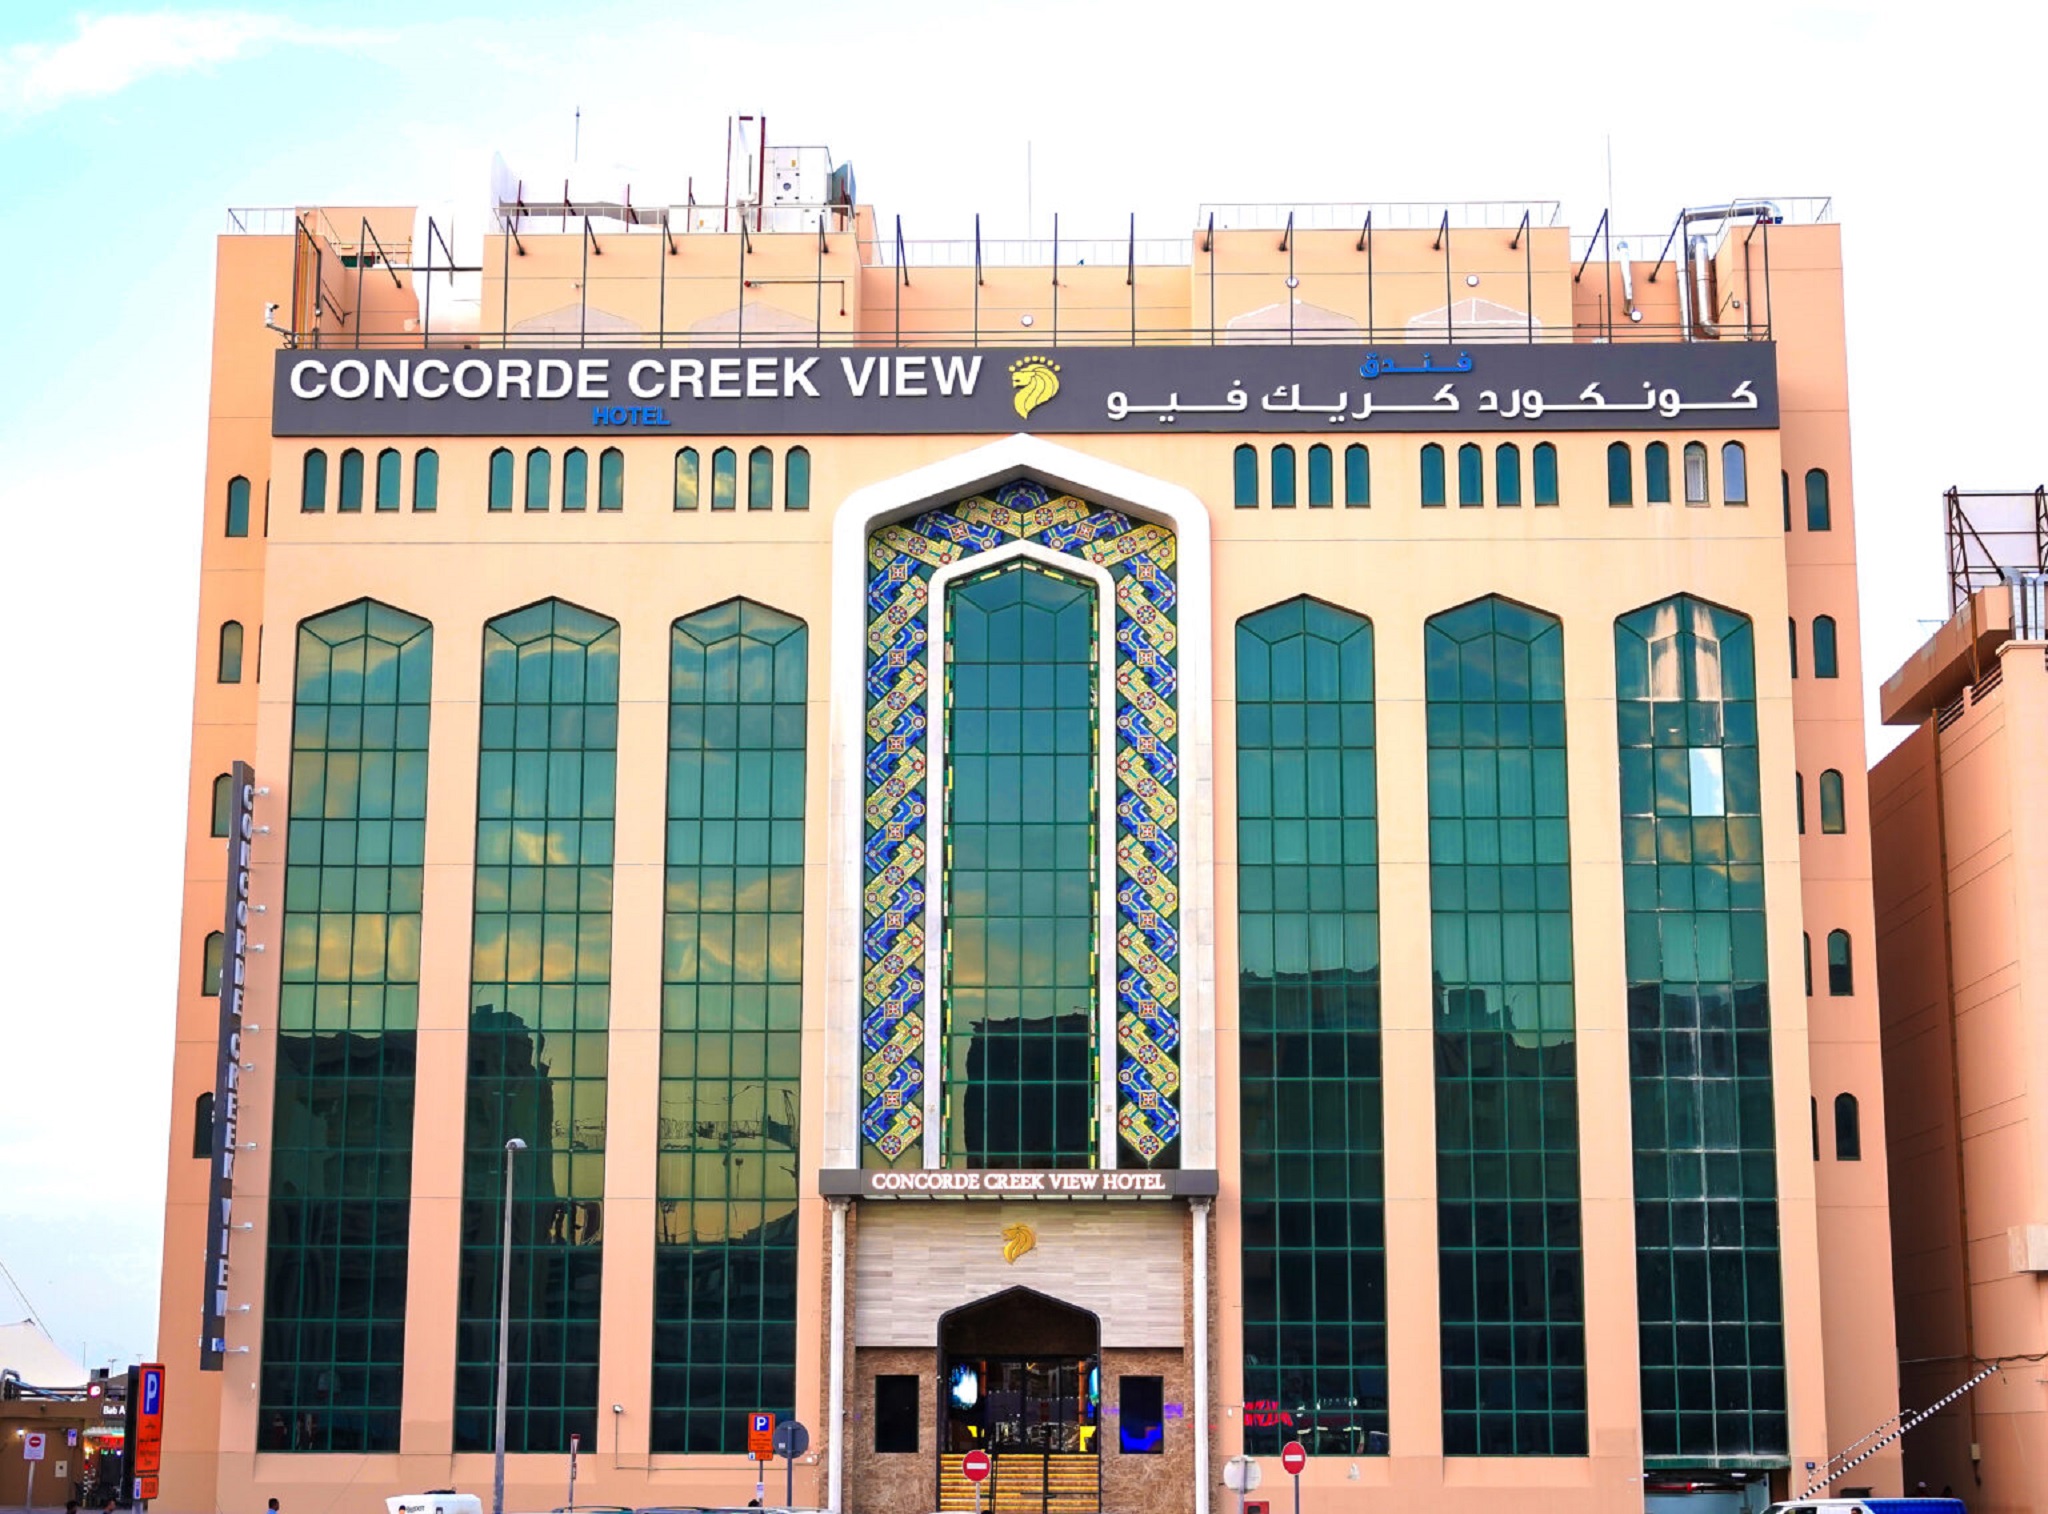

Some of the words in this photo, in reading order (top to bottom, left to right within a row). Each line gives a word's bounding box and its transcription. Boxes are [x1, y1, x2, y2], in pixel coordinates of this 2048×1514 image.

[290, 358, 609, 400] CONCORDE
[628, 357, 820, 399] CREEK
[841, 355, 982, 397] VIEW
[1360, 352, 1473, 378] فندق
[592, 406, 671, 426] HOTEL
[1107, 379, 1249, 422] فيو
[1261, 383, 1460, 423] كريك
[1478, 380, 1758, 418] كونكورد
[232, 784, 253, 1017] CONCORDE
[223, 1033, 240, 1179] CREEK
[872, 1173, 980, 1190] CONCORDE
[984, 1173, 1044, 1190] CREEK
[1049, 1173, 1098, 1190] VIEW
[1103, 1173, 1165, 1190] HOTEL
[146, 1374, 158, 1412] P
[756, 1417, 766, 1430] P
